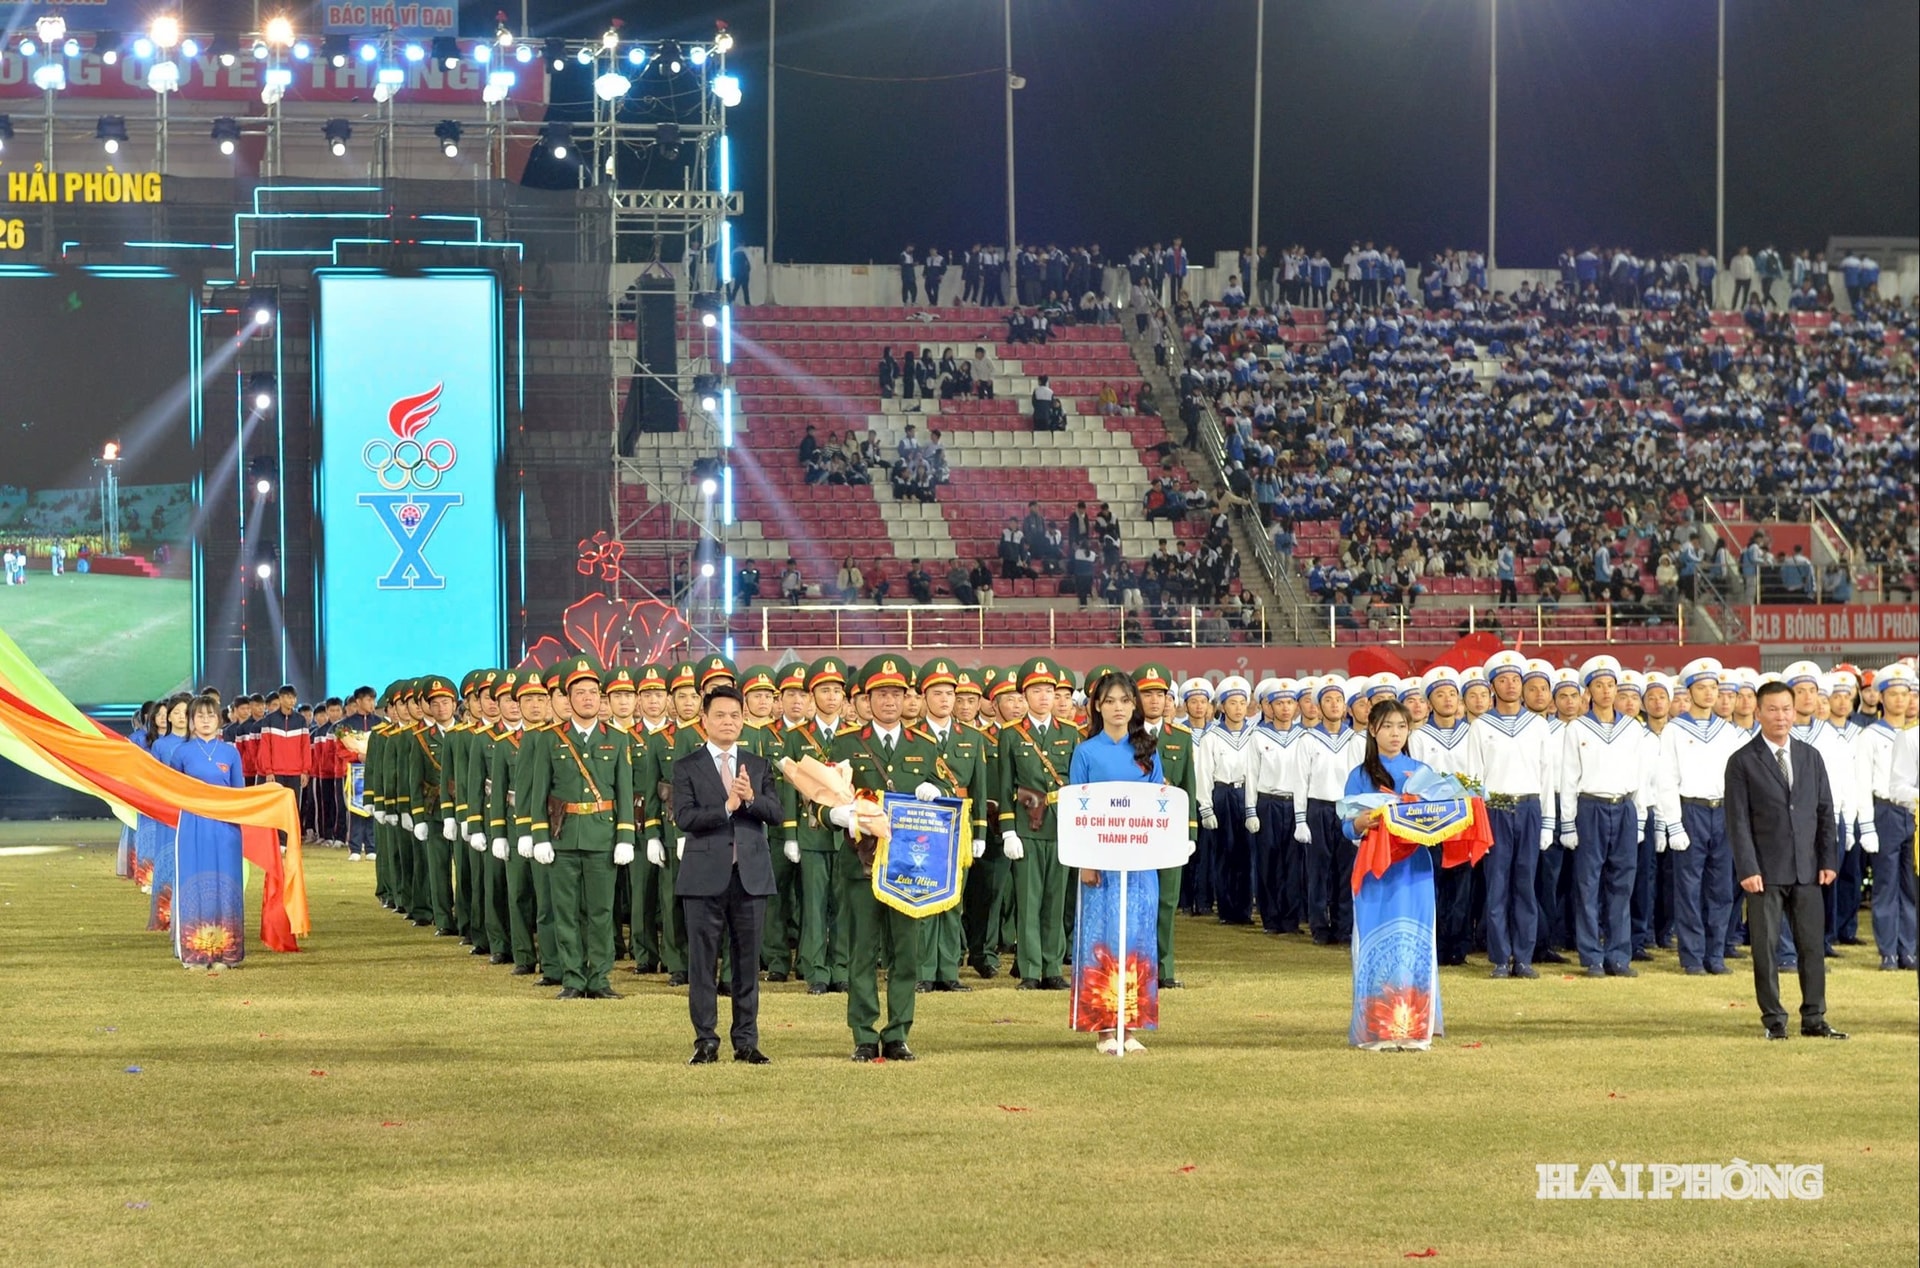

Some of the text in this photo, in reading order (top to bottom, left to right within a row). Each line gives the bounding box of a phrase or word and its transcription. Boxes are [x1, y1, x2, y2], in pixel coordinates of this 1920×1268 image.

[329, 3, 365, 25] BÁC
[422, 8, 452, 30] ĐẠI
[309, 52, 480, 90] THNG
[8, 162, 162, 203] HẢI PHÒNG
[1753, 613, 1781, 640] CLB
[1785, 607, 1826, 640] BÓNG
[1830, 607, 1850, 640] ĐÁ
[1854, 604, 1879, 639] HẢI
[1110, 795, 1131, 809] KHỐI
[1075, 813, 1170, 831] BỘ CHỈ HUY QUÂN SỰ
[1098, 831, 1149, 845] THÀNH PHỐ
